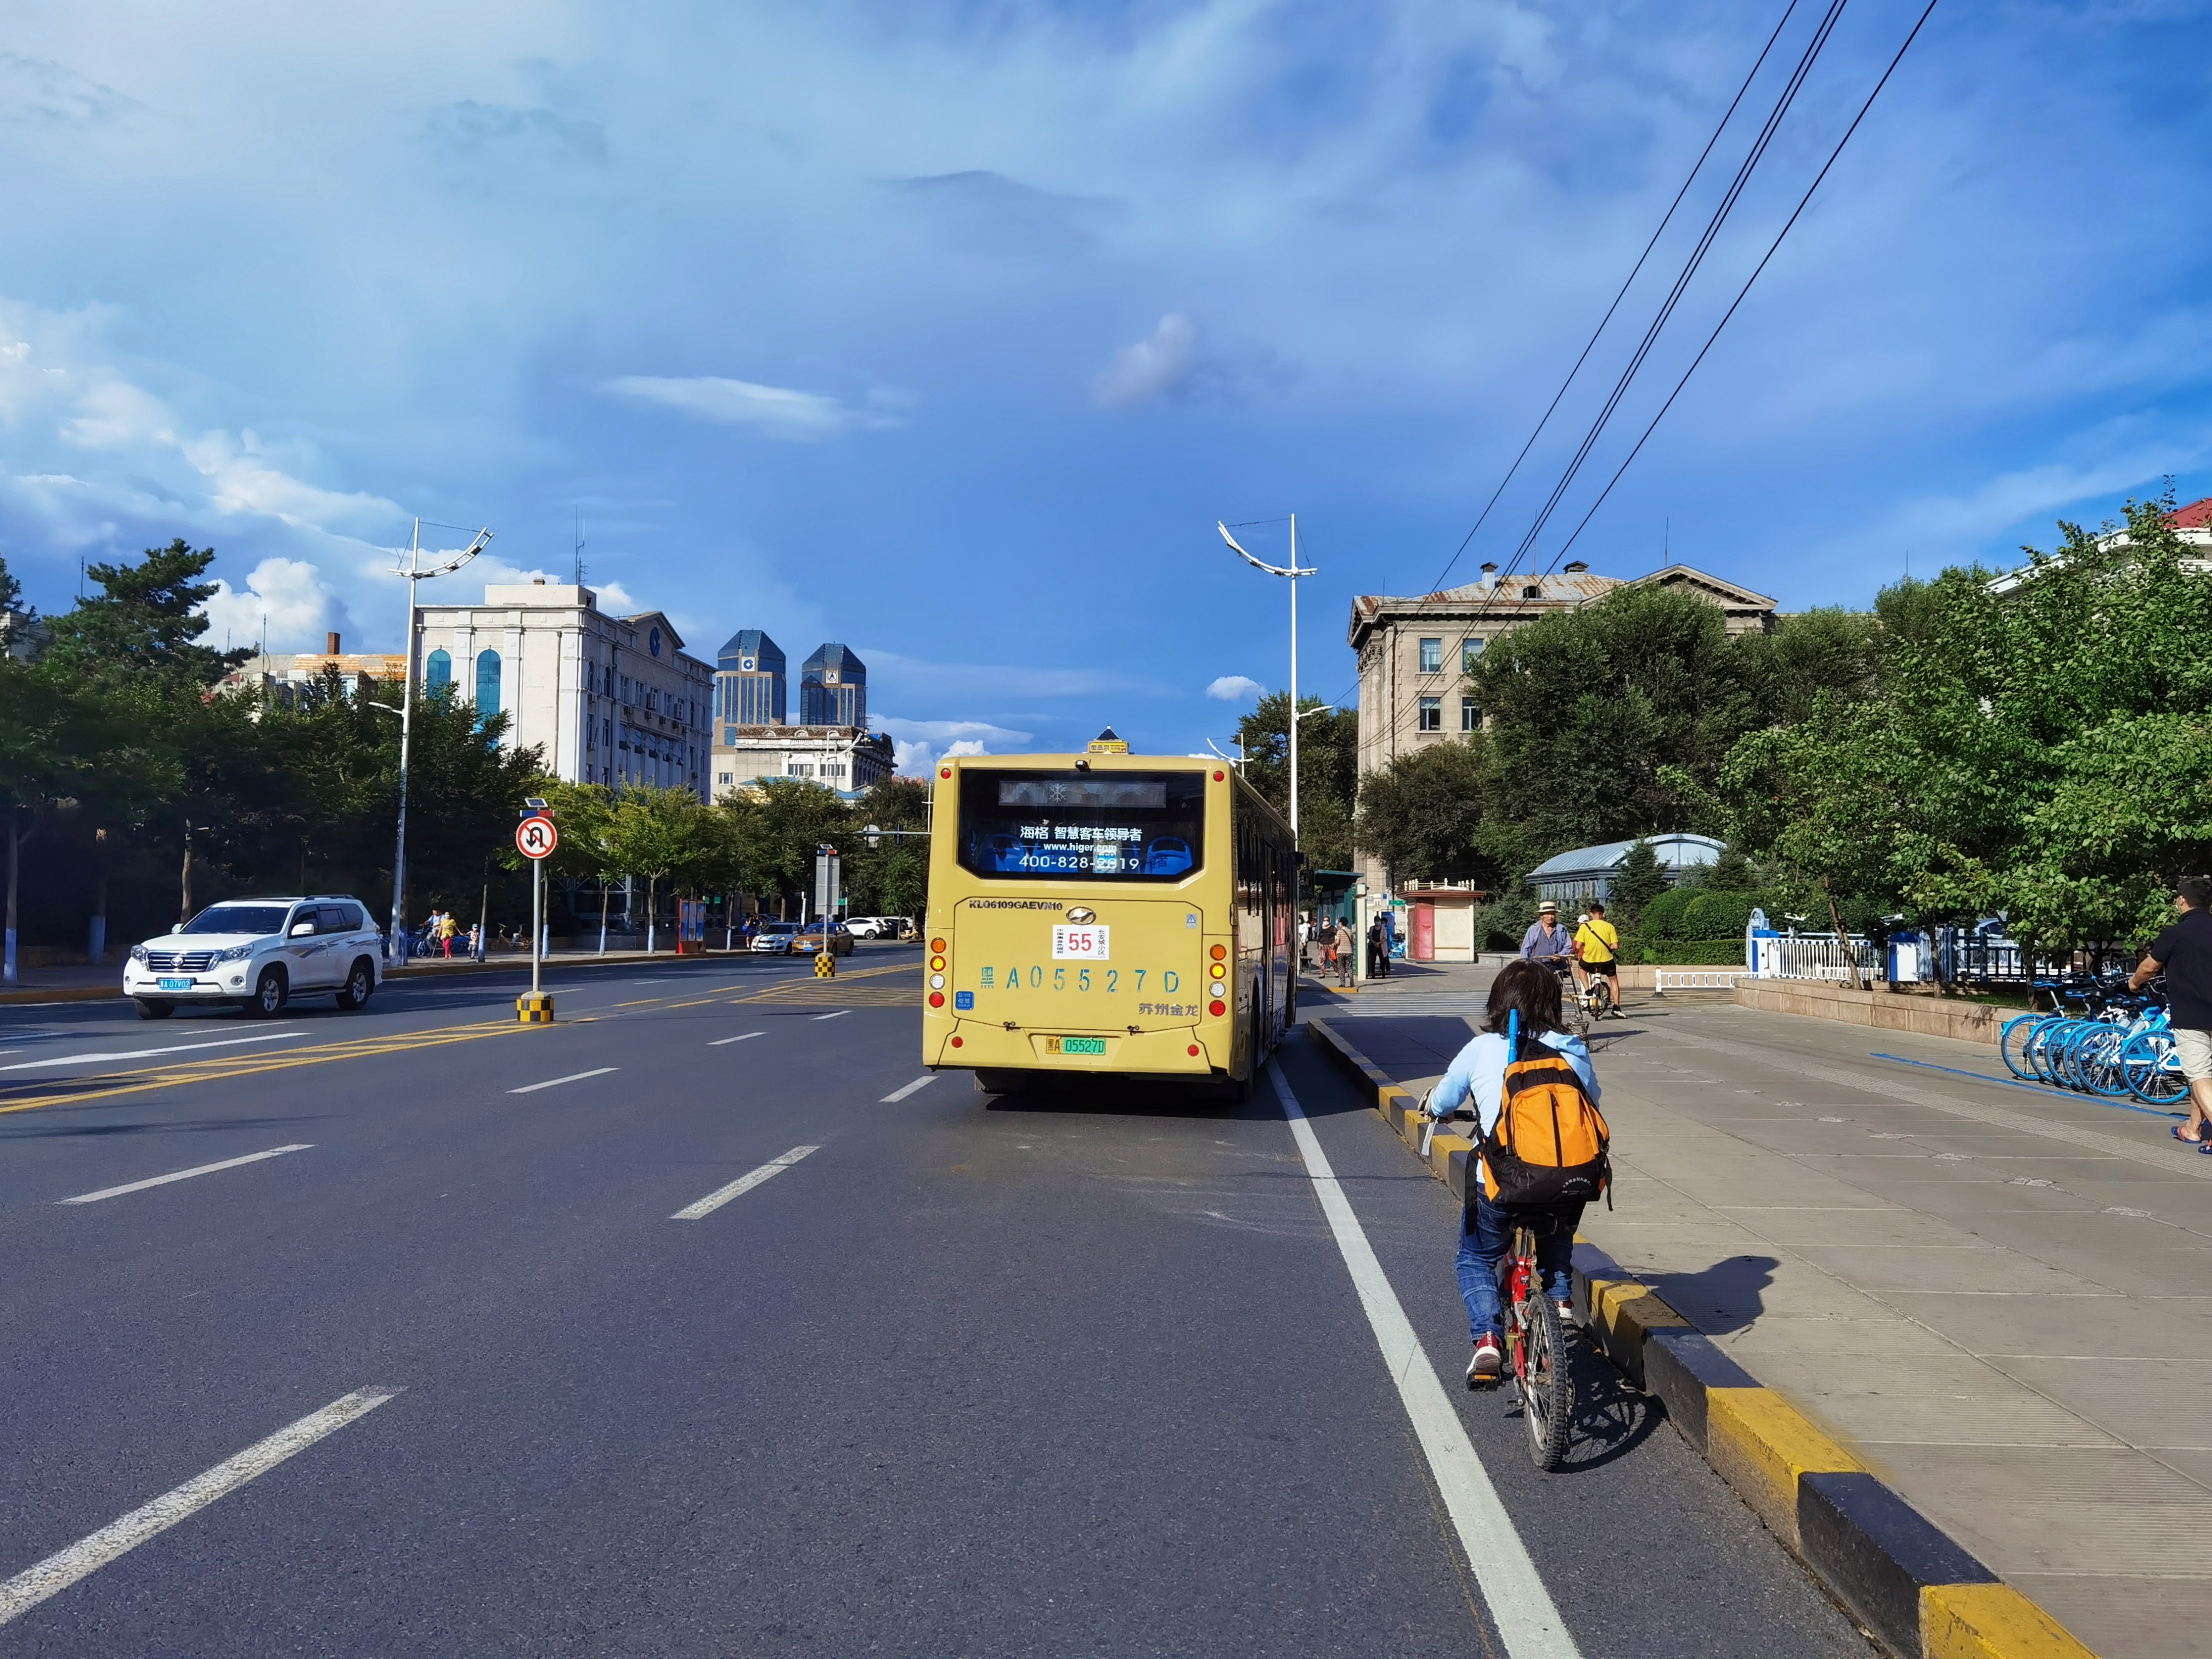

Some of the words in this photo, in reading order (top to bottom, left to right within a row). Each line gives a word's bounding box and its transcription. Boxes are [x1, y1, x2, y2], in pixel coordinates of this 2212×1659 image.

[1020, 826, 1049, 839] 海格
[1054, 826, 1143, 842] 智慧客车领导者
[1043, 843, 1117, 853] www.higer.com
[1018, 856, 1139, 870] 400-828-2019
[1069, 933, 1092, 951] 55
[1138, 1002, 1198, 1017] 苏州金龙
